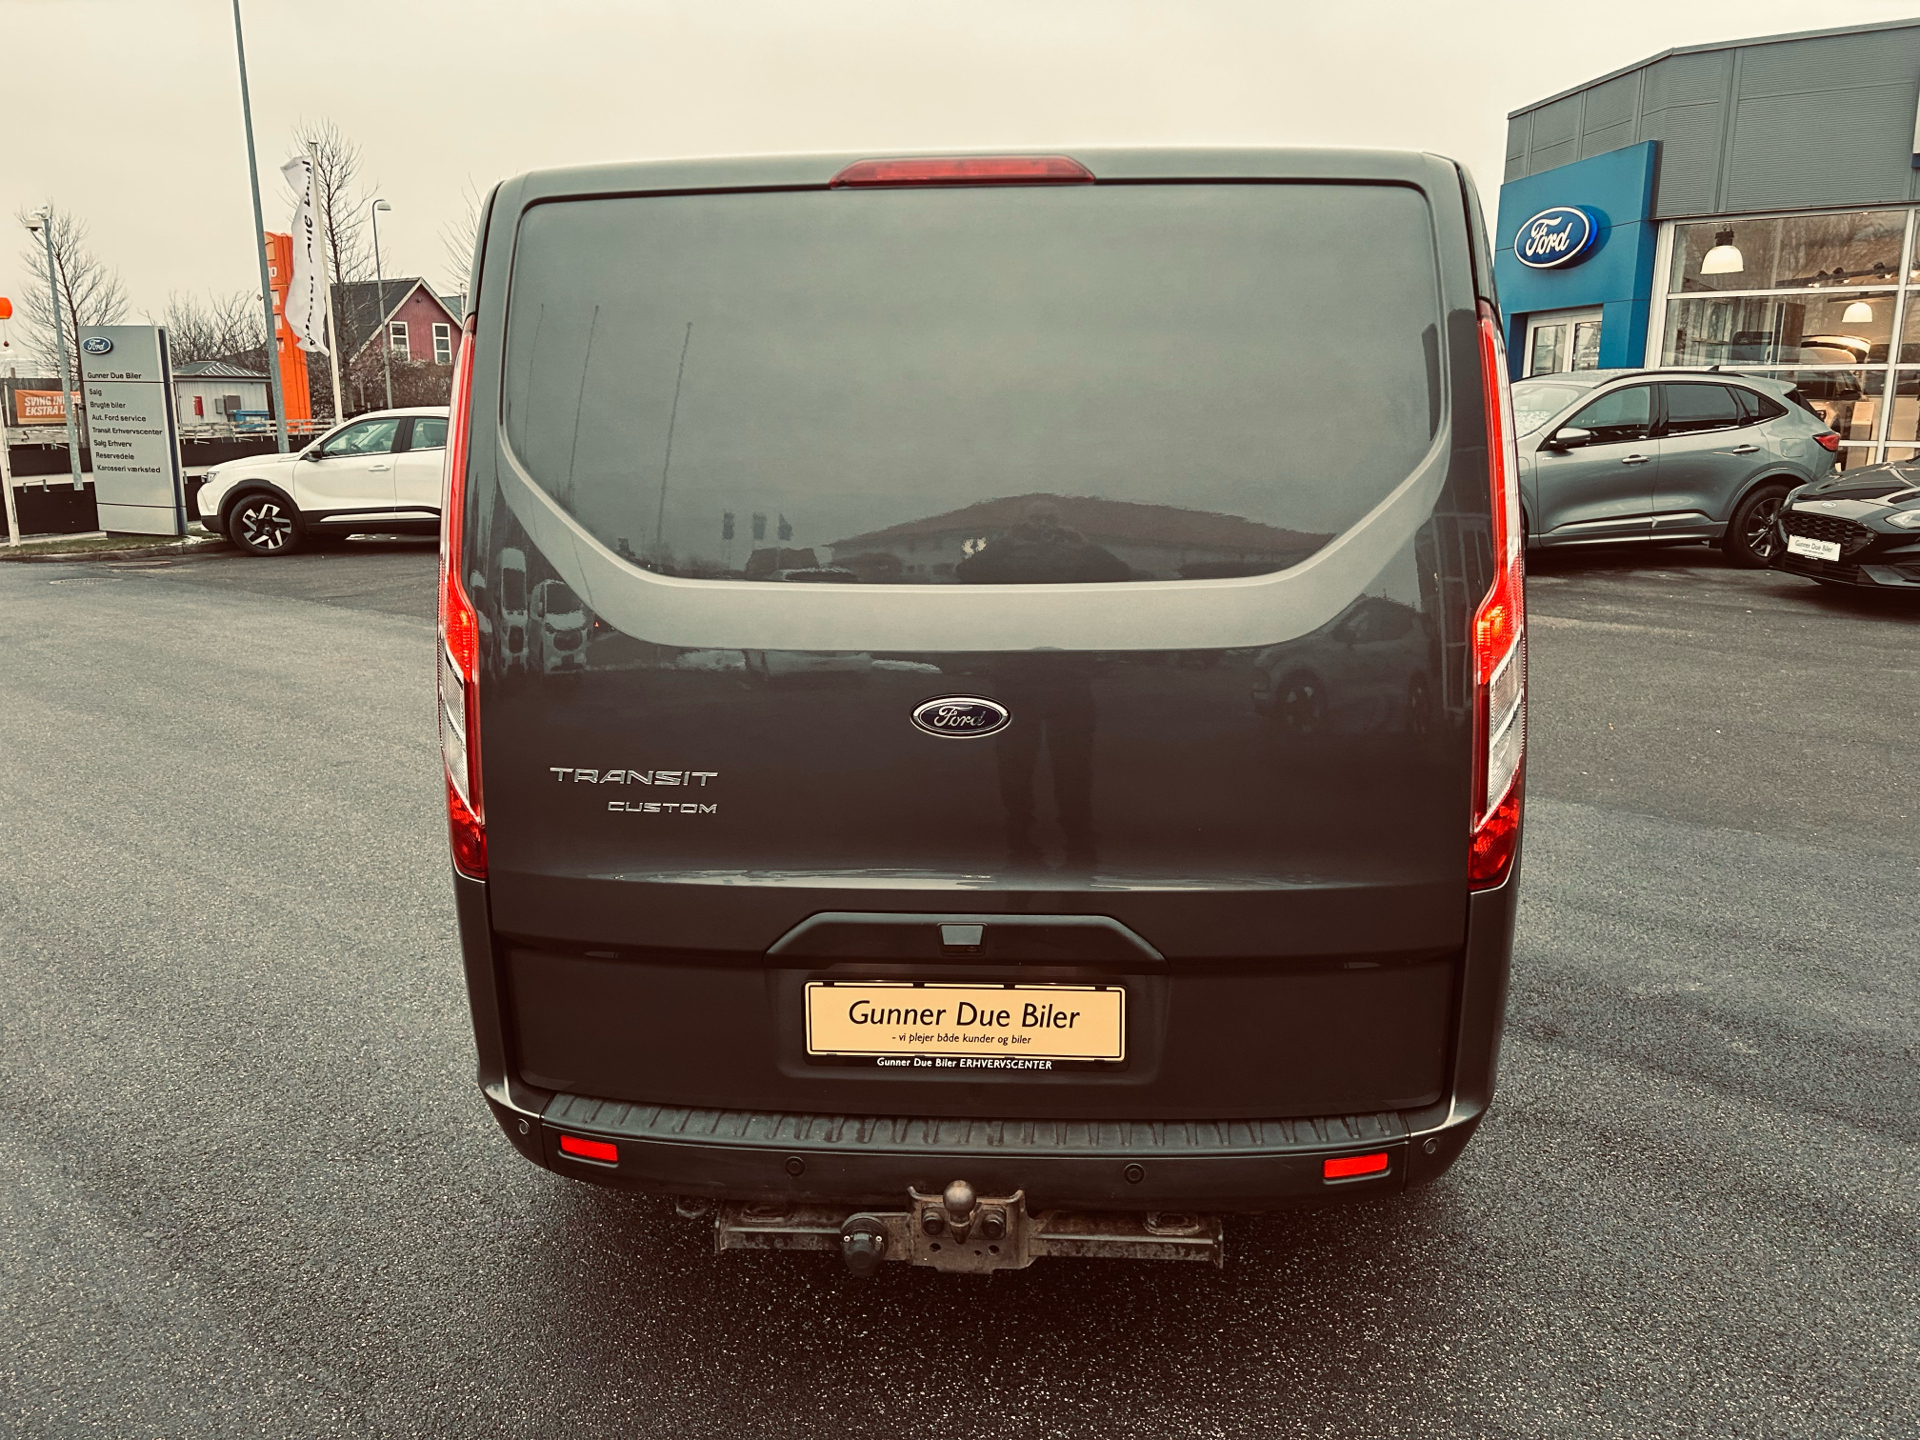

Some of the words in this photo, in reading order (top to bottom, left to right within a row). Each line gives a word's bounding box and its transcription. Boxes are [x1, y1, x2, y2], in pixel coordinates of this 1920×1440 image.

[1525, 216, 1573, 257] Ford
[89, 388, 102, 397] Salg
[24, 396, 51, 406] SVING
[90, 401, 110, 409] Brugte
[25, 405, 58, 416] EKSTRA
[94, 440, 107, 448] Salg
[96, 452, 134, 460] Reservedele
[934, 705, 986, 727] Ford
[549, 767, 718, 787] TRANSIT
[607, 801, 718, 814] CUSTOM
[848, 1000, 947, 1025] Gunner
[956, 1001, 1011, 1028] Due
[1021, 1003, 1080, 1029] Biler
[899, 1033, 906, 1041] vi
[909, 1032, 934, 1044] plejer
[937, 1033, 959, 1043] både
[963, 1034, 995, 1043] kunder
[997, 1037, 1009, 1046] og
[1011, 1035, 1032, 1044] biler
[877, 1058, 911, 1067] Gunner
[913, 1058, 932, 1067] Due
[935, 1059, 957, 1068] Biler
[960, 1059, 1052, 1070] ERHVERVSCENTER
